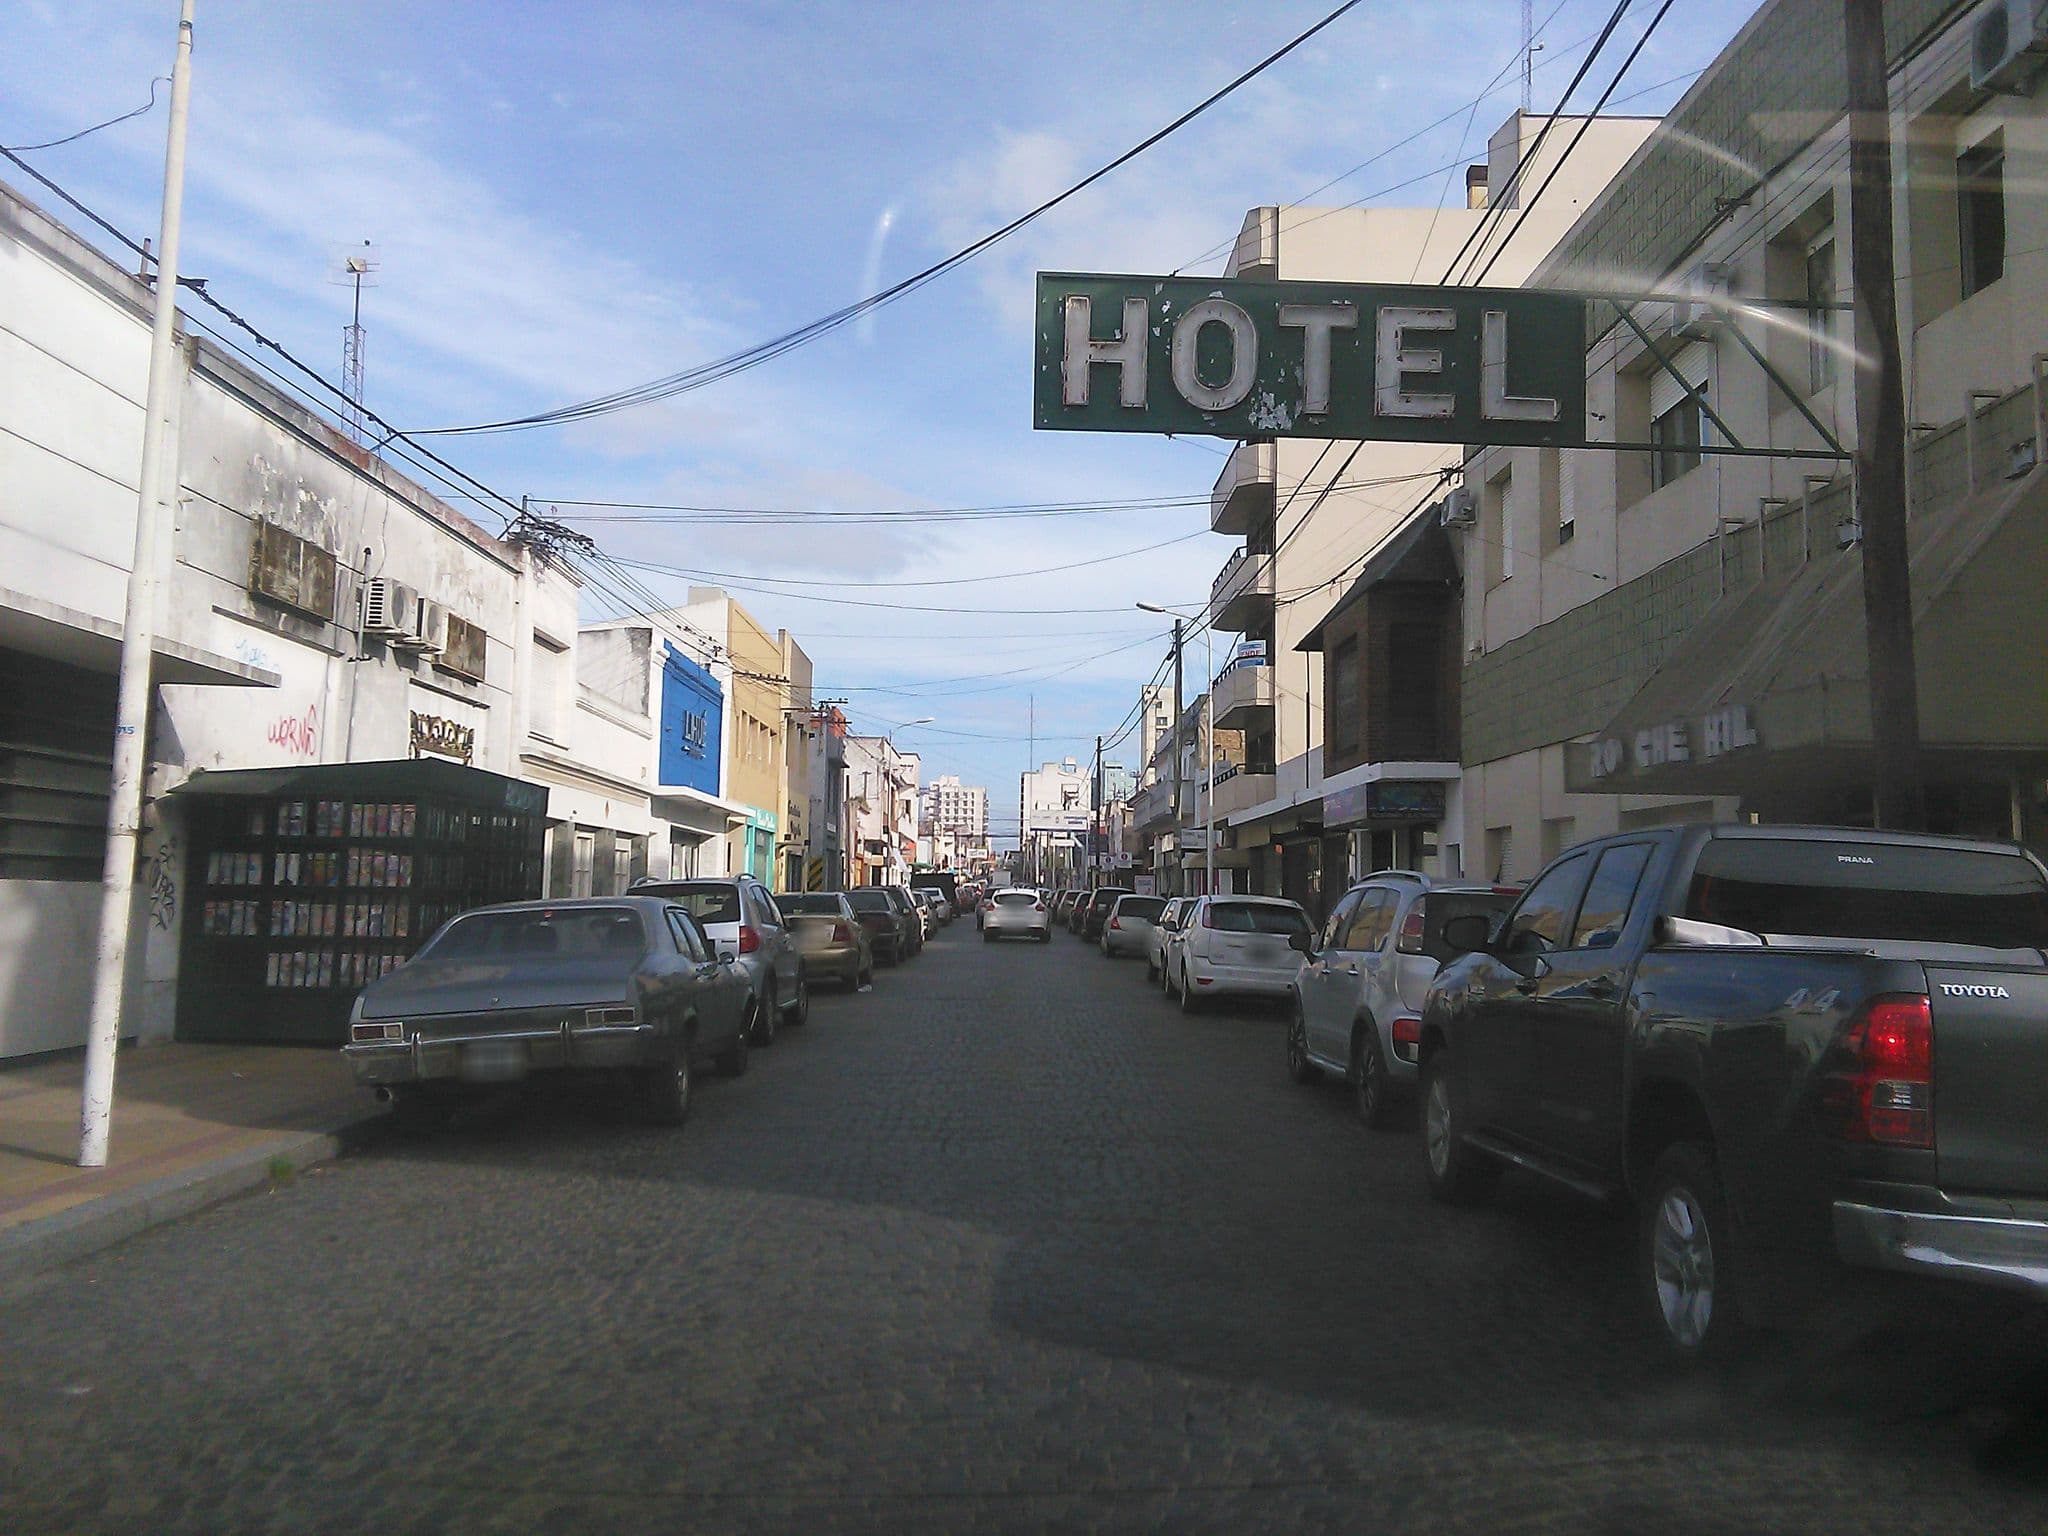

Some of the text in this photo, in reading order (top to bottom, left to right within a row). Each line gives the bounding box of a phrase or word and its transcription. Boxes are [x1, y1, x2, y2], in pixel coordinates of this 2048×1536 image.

[1063, 294, 1560, 421] HOTEL
[1838, 855, 1874, 864] PRANA
[1940, 983, 2009, 999] TOYOTA
